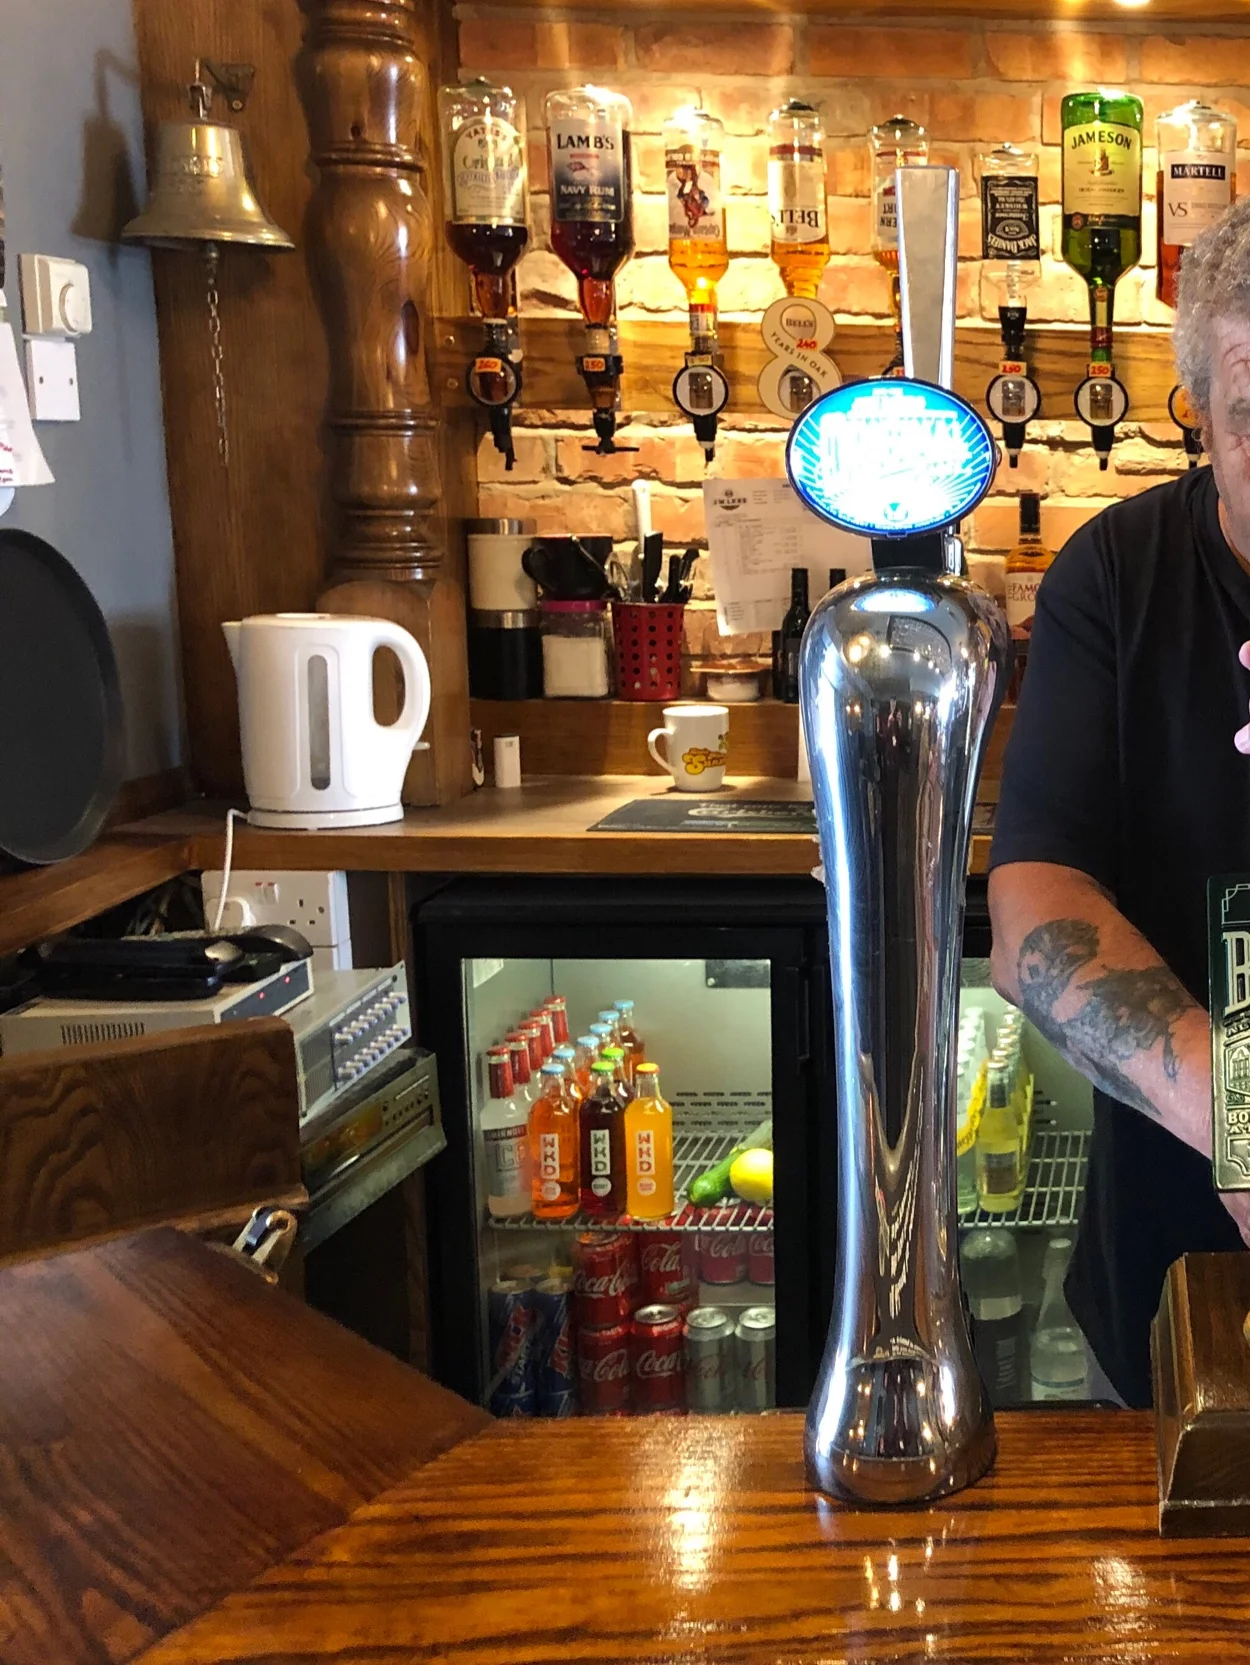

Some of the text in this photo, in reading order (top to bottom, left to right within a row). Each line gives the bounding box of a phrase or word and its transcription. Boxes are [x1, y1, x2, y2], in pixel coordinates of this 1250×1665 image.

[557, 133, 615, 150] LAMB'S
[1071, 130, 1132, 150] JAMESON
[1173, 164, 1225, 178] MARTELL
[560, 185, 615, 196] NAVY RUM
[1168, 202, 1188, 218] VS
[1018, 233, 1037, 250] JACK
[771, 332, 828, 378] YEARS IN OAK
[542, 1136, 556, 1177] WKD
[593, 1132, 608, 1172] WKD
[638, 1132, 652, 1173] WKD
